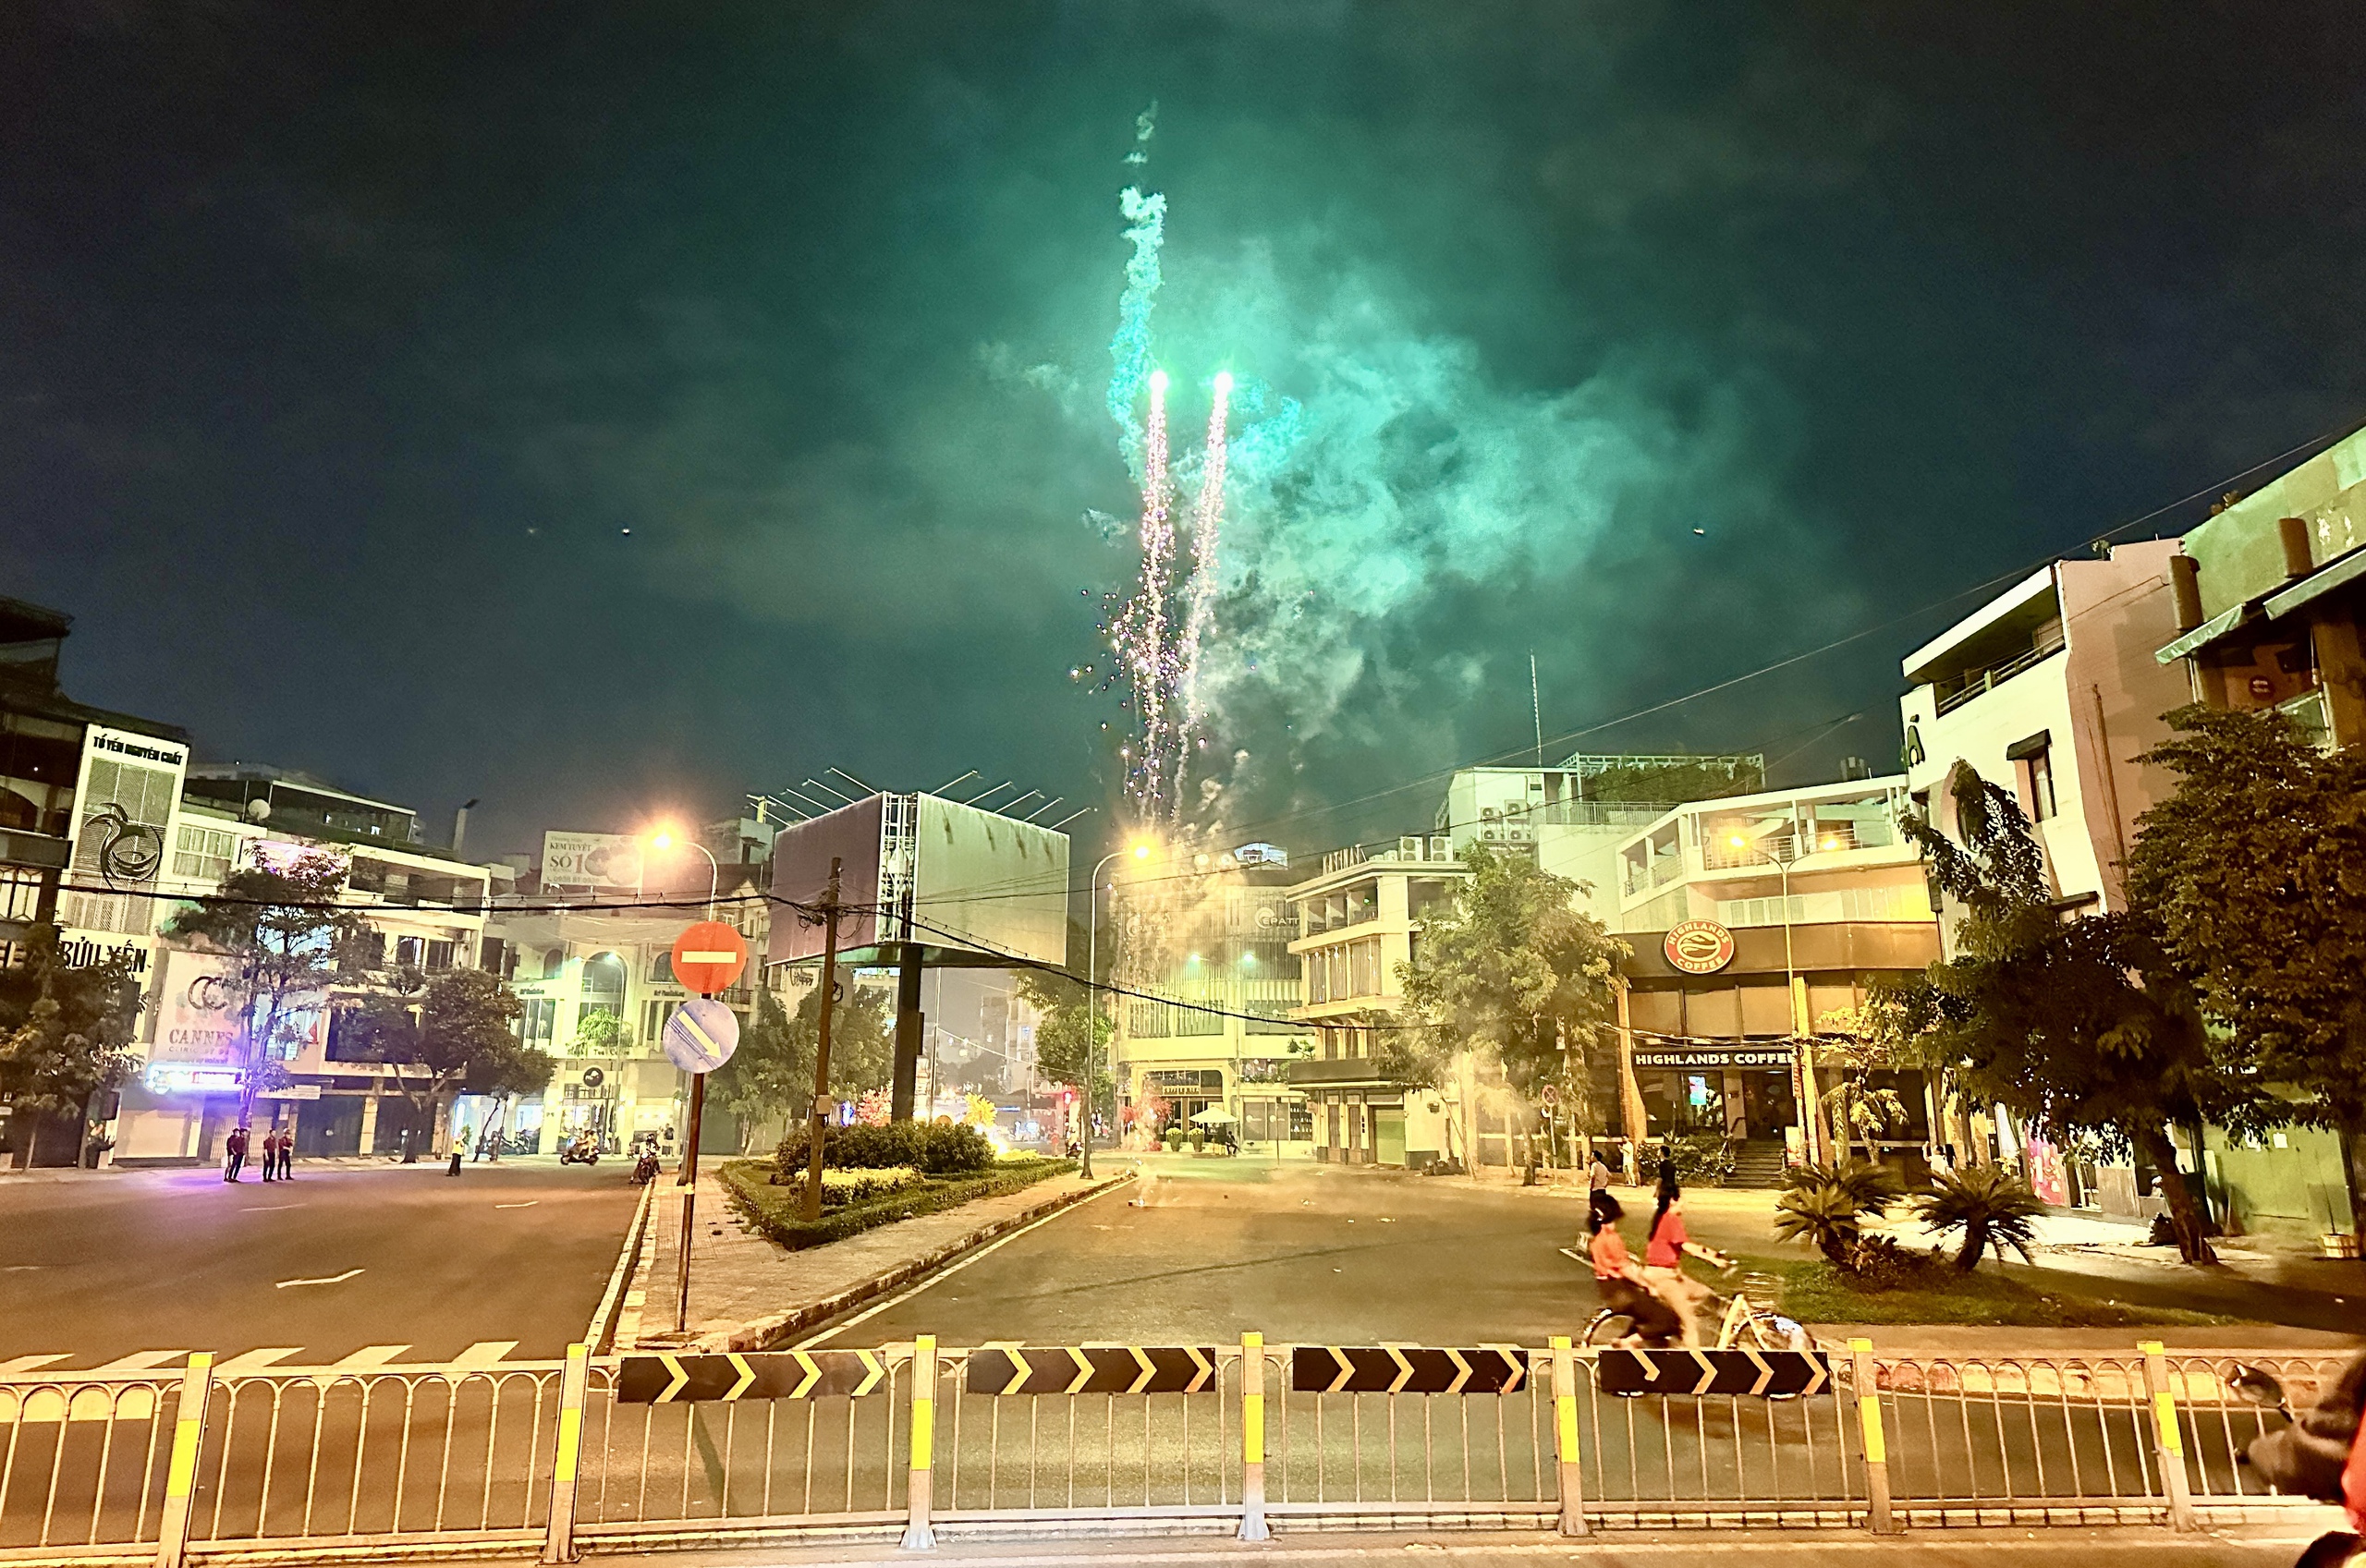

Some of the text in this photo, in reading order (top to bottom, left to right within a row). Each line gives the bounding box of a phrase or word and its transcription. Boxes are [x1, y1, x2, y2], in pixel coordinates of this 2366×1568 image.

[1667, 922, 1730, 945] HIGHLANDS
[1677, 955, 1725, 970] COFFEE
[168, 1028, 234, 1048] CANNES
[1635, 1053, 1730, 1065] HIGHLANDS
